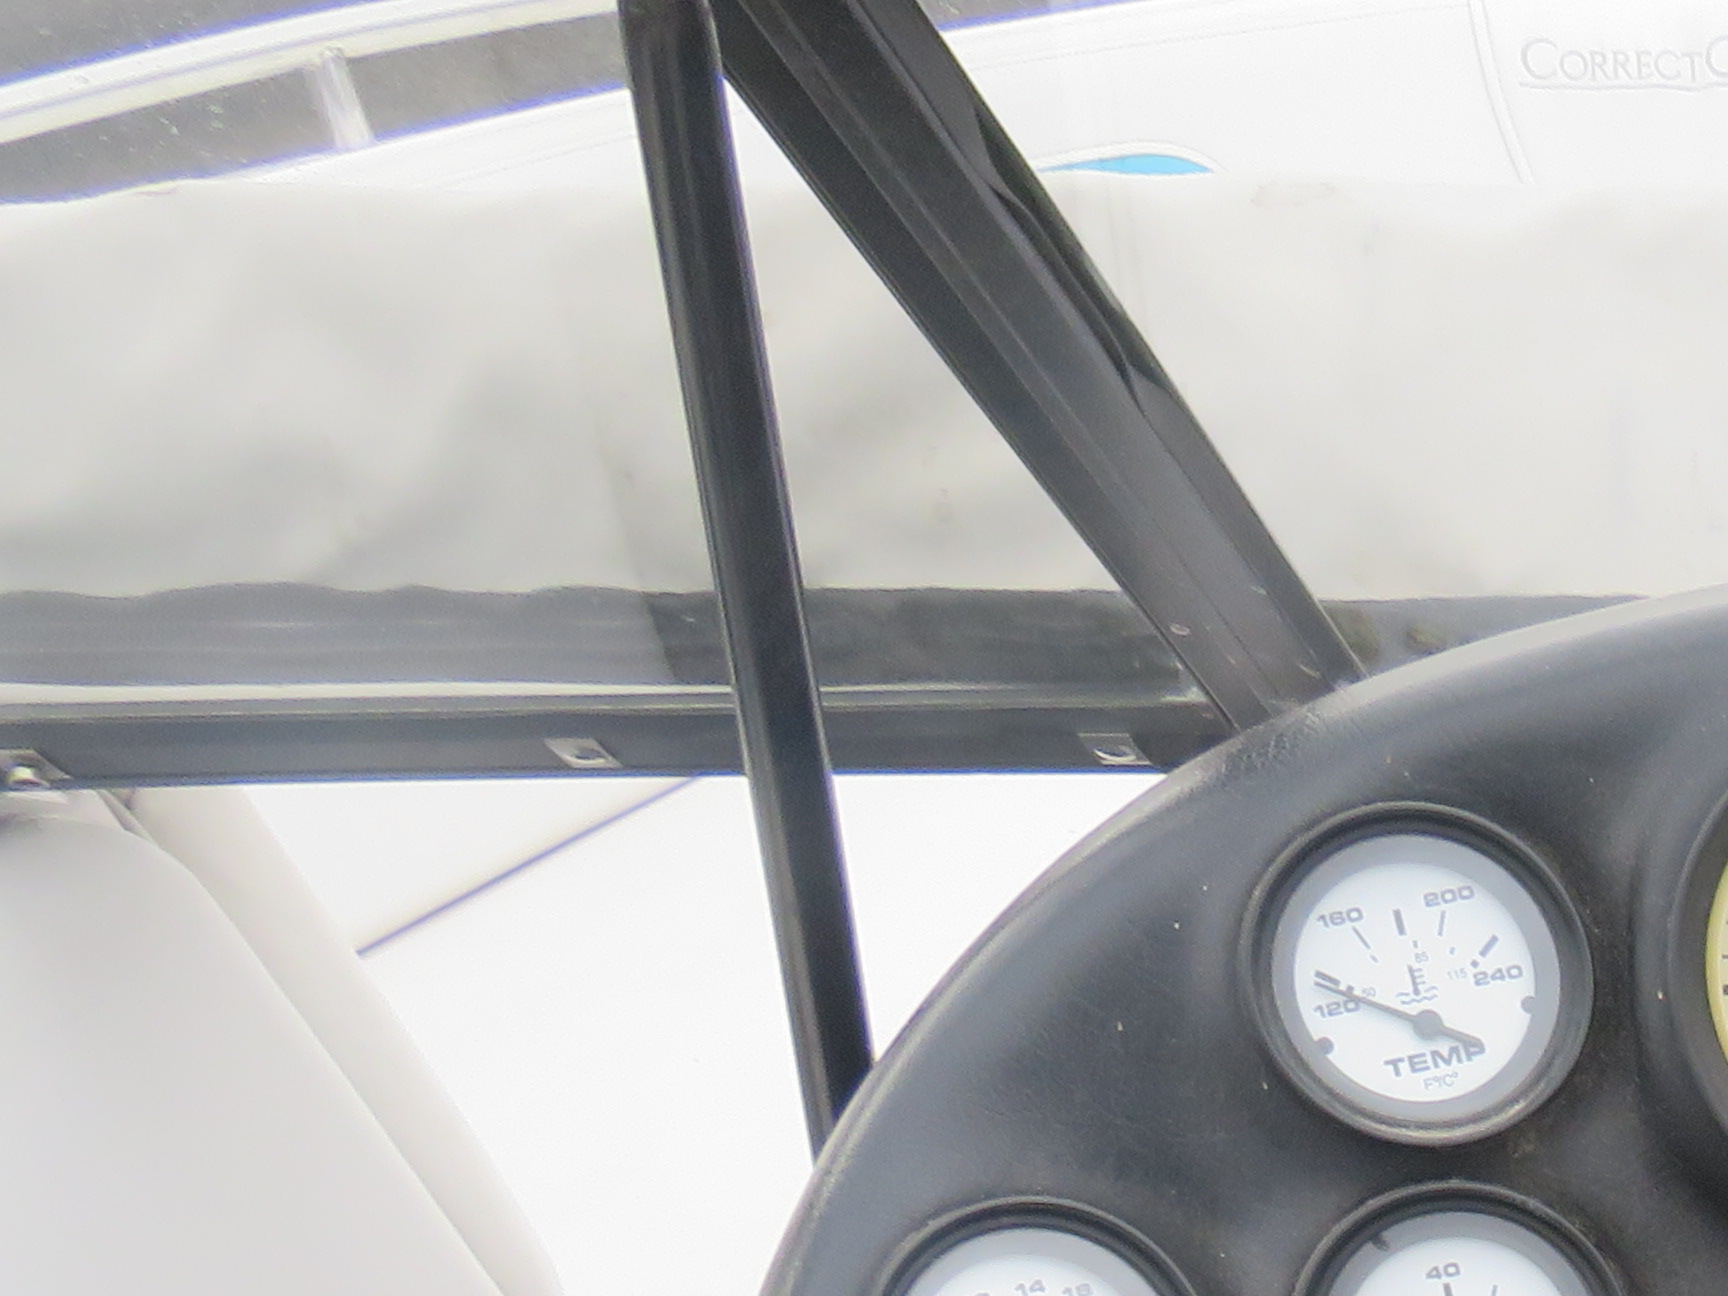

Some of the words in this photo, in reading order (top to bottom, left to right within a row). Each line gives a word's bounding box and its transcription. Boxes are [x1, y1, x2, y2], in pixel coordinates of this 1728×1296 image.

[1423, 884, 1476, 907] 200
[1316, 907, 1364, 930] 160
[1473, 965, 1524, 987] 240
[1314, 996, 1360, 1018] 120
[1384, 1042, 1486, 1078] TEMP
[1425, 1262, 1462, 1281] 40
[1015, 1279, 1046, 1296] 14
